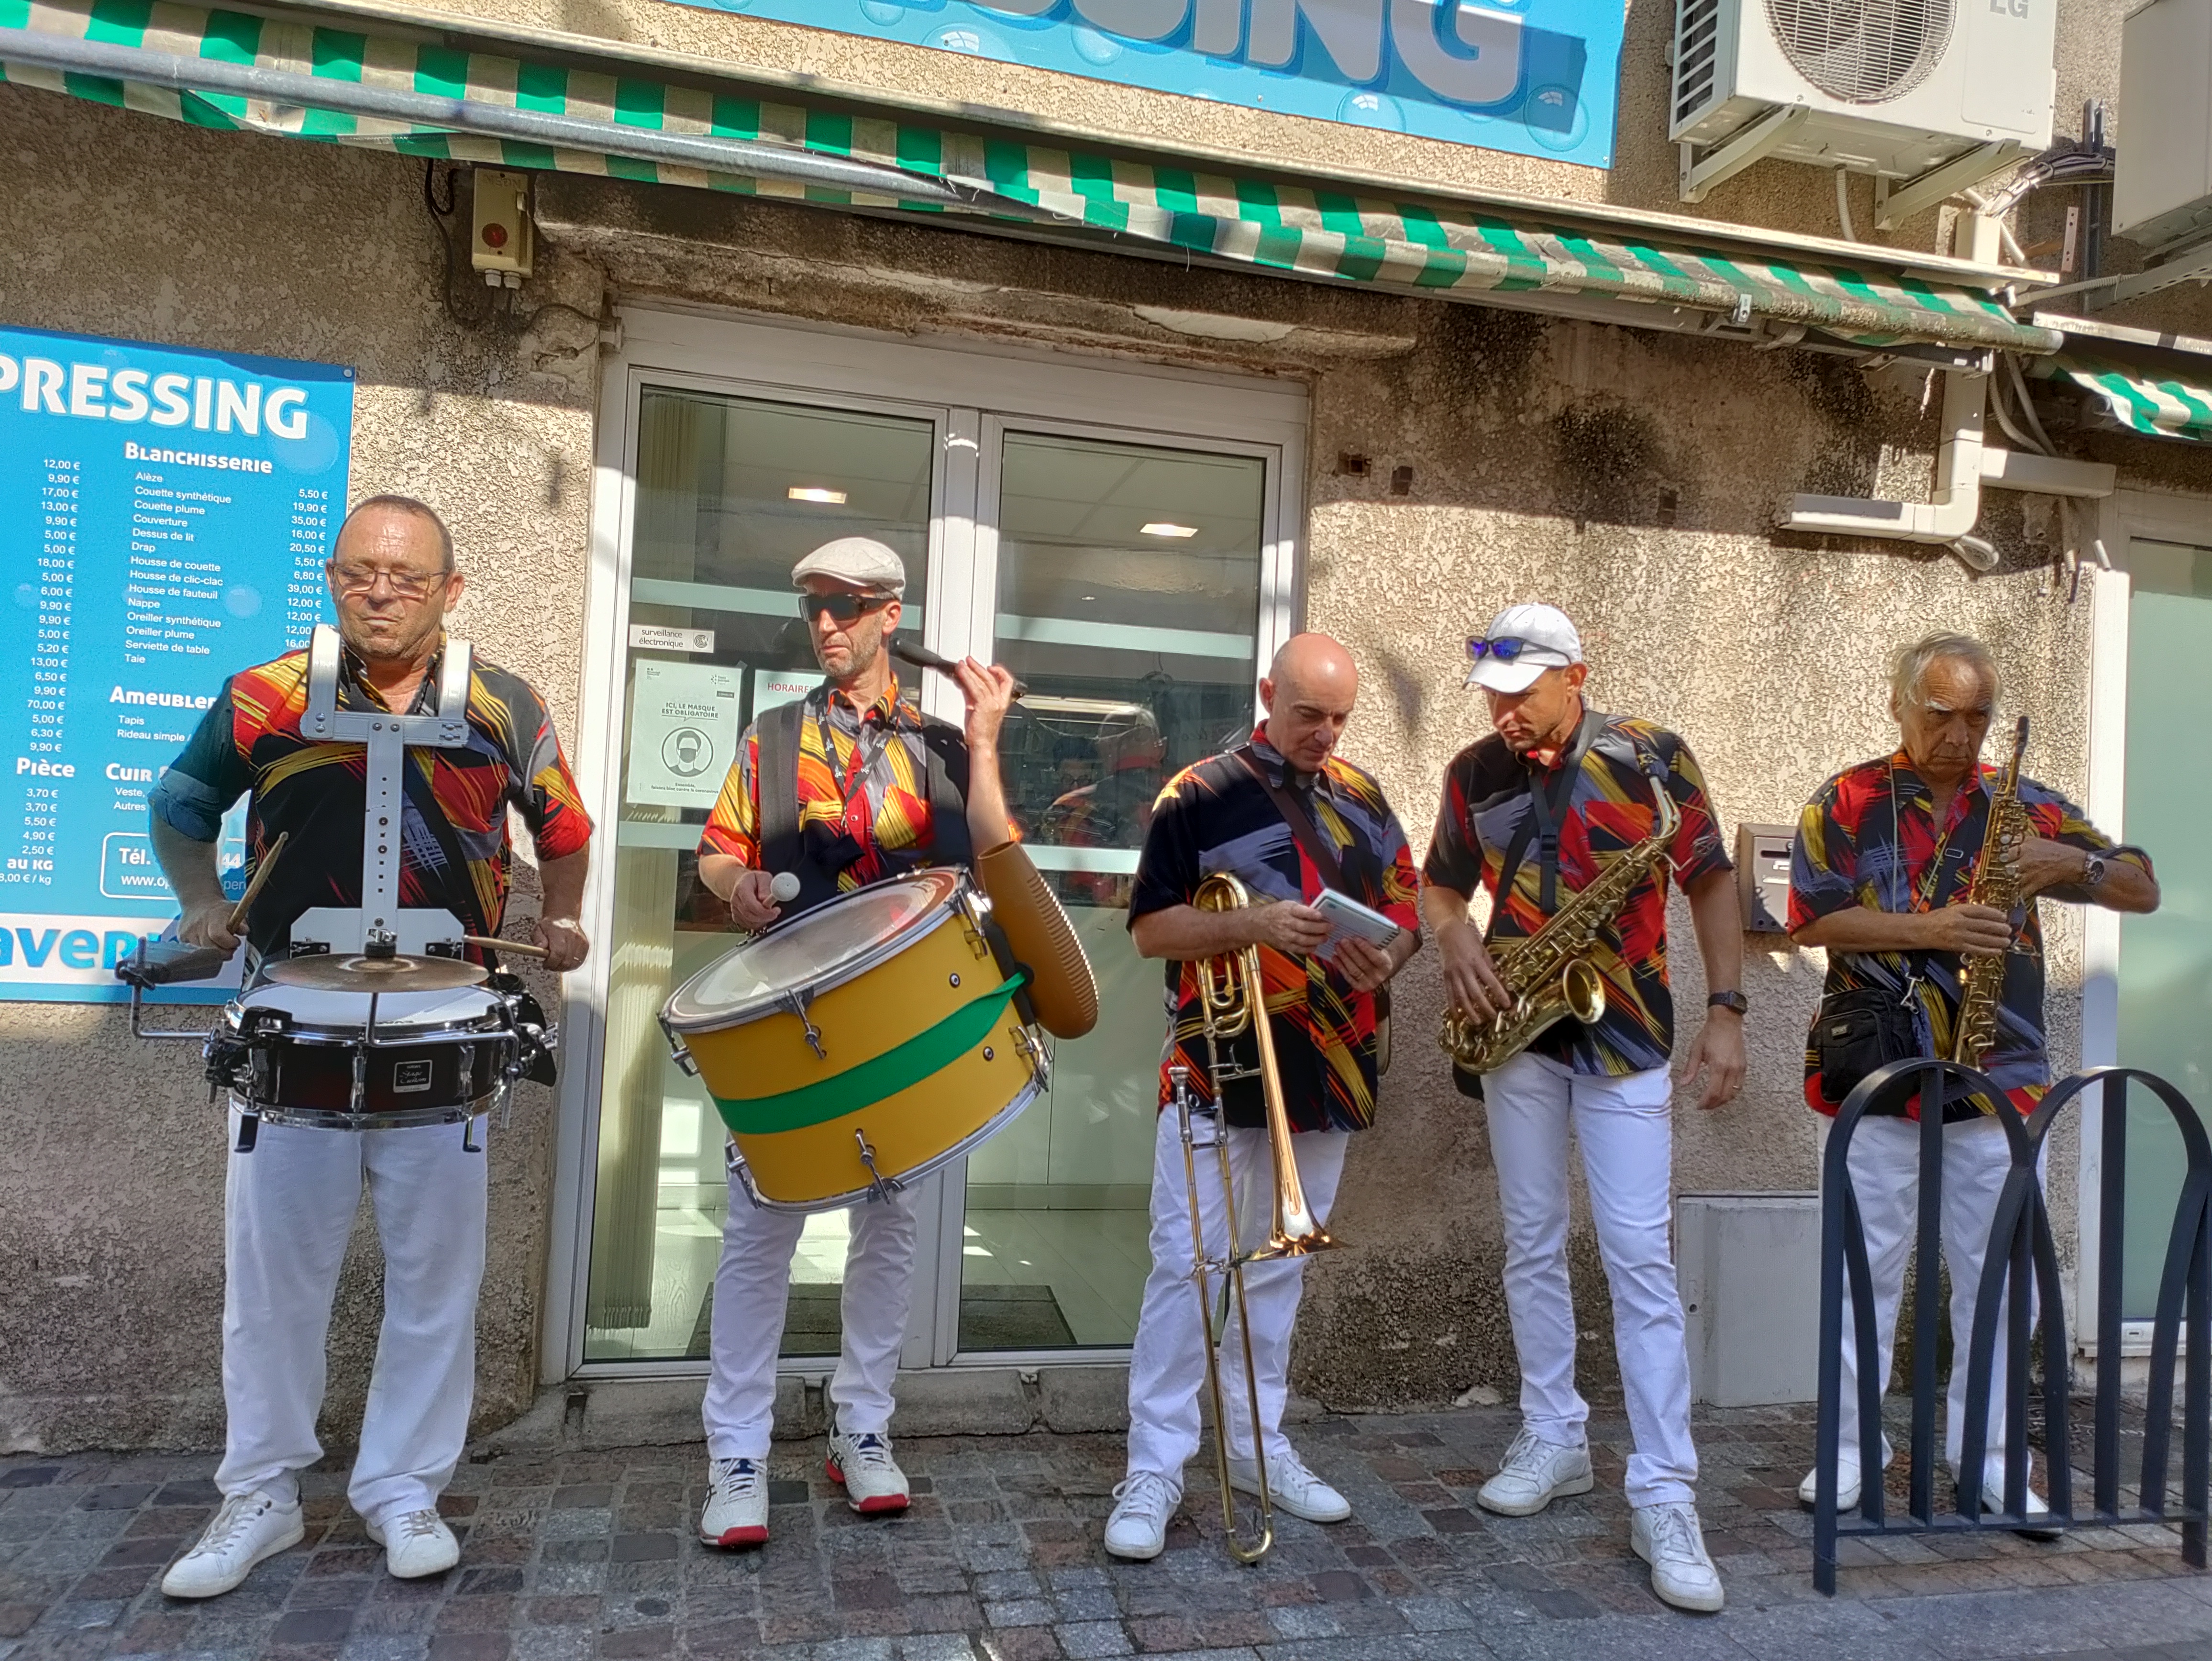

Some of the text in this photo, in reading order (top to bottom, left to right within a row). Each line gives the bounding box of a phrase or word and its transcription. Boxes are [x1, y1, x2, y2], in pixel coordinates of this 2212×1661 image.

[44, 459, 80, 470] 12,00 €
[48, 474, 79, 484] 9,90 €
[135, 472, 163, 482] Alèze
[42, 487, 78, 498] 17,00 €
[135, 486, 231, 503] Couette synthétique
[299, 489, 328, 499] 5,50 €
[41, 501, 77, 512] 13,00 €
[134, 499, 205, 515] Couette plume
[293, 502, 327, 513] 19,90 €
[45, 516, 77, 527] 9,90 €
[133, 514, 188, 527] Couverture
[291, 516, 326, 527] 35,00 €
[45, 530, 76, 541] 5,00 €
[133, 528, 194, 542] Dessus de lit
[292, 529, 326, 541] 16,00 €
[44, 544, 75, 554] 5,00 €
[132, 542, 155, 553] Drap
[289, 543, 325, 554] 20,50 €
[38, 558, 74, 569] 18,00 €
[131, 556, 221, 572] Housse de couette
[295, 557, 324, 568] 5,50 €
[42, 573, 73, 583] 5,00 €
[130, 570, 223, 586] Housse de clic-clac
[294, 571, 324, 581] 6,80 €
[41, 587, 72, 597] 6,00 €
[129, 584, 218, 599] Housse de fauteuil
[288, 584, 322, 595] 39,00 €
[40, 601, 71, 611] 9,90 €
[128, 598, 160, 609] Nappe
[288, 598, 322, 609] 12,00 €
[39, 615, 70, 625] 9,90 €
[127, 612, 221, 628] Oreiller synthétique
[287, 611, 321, 622] 12,00 €
[38, 630, 69, 639] 5,00 €
[126, 626, 195, 639] Oreiller plume
[286, 625, 311, 635] 12,00
[641, 629, 683, 638] surveillance
[37, 643, 69, 653] 5,20 €
[125, 640, 210, 654] Serviette de table
[639, 637, 684, 648] électronique
[31, 657, 68, 668] 13,00 €
[124, 653, 145, 663] Taie
[35, 672, 66, 682] 6,50 €
[34, 686, 66, 696] 9,90 €
[28, 699, 65, 710] 70,00 €
[33, 714, 64, 724] 5,00 €
[675, 709, 719, 718] OBLIGATOIRE
[119, 715, 144, 725] Tapis
[31, 729, 62, 738] 6,30 €
[117, 729, 151, 739] Rideau
[154, 732, 185, 742] simple
[30, 742, 62, 752] 9,90 €
[27, 788, 58, 798] 3,70 €
[26, 802, 57, 812] 3,70 €
[113, 801, 146, 811] Autres
[24, 817, 56, 827] 5,50 €
[23, 831, 55, 841] 4,90 €
[22, 845, 54, 855] 2,50 €
[119, 848, 151, 865] Tél.
[7, 859, 28, 869] au
[23, 874, 30, 883] €
[32, 875, 37, 883] /
[39, 875, 51, 886] kg
